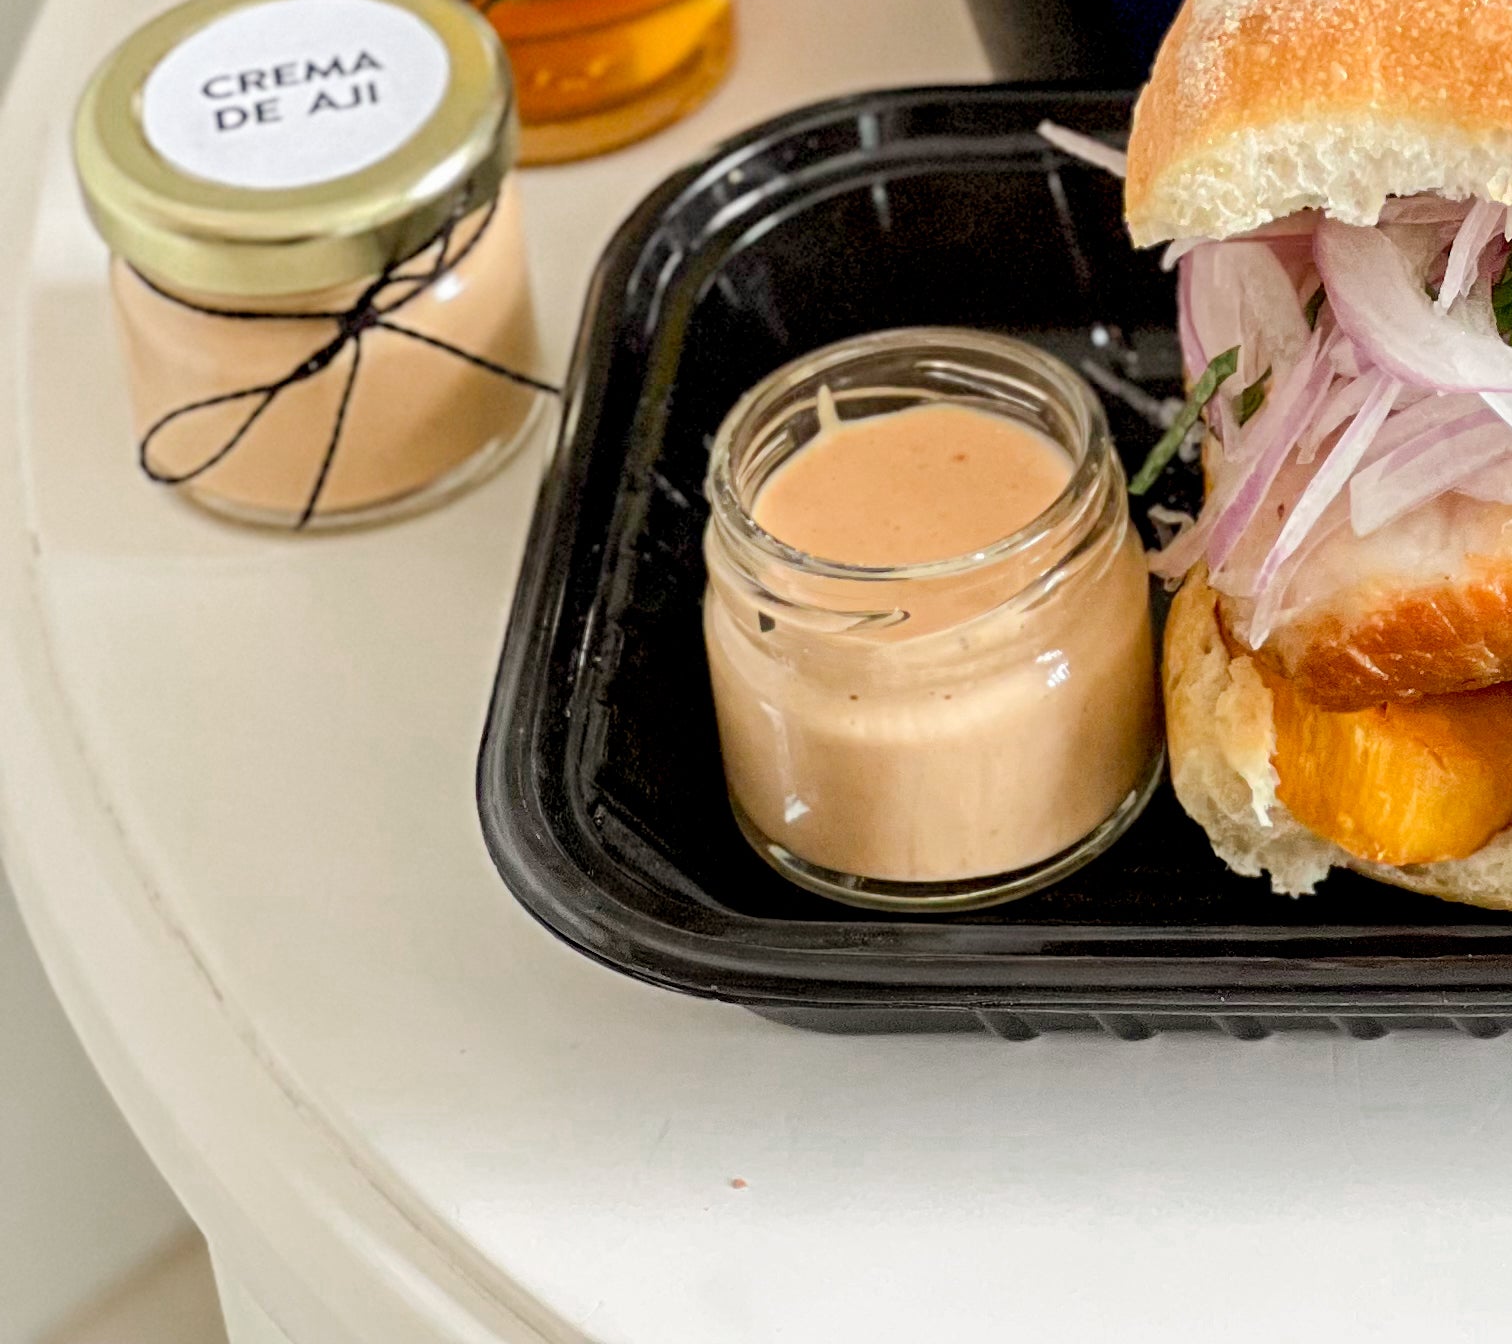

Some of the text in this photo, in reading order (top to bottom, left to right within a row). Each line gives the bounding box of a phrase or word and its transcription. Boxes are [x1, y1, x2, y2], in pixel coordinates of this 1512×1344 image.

[201, 50, 384, 100] CREMA
[214, 80, 379, 133] DE AJI
